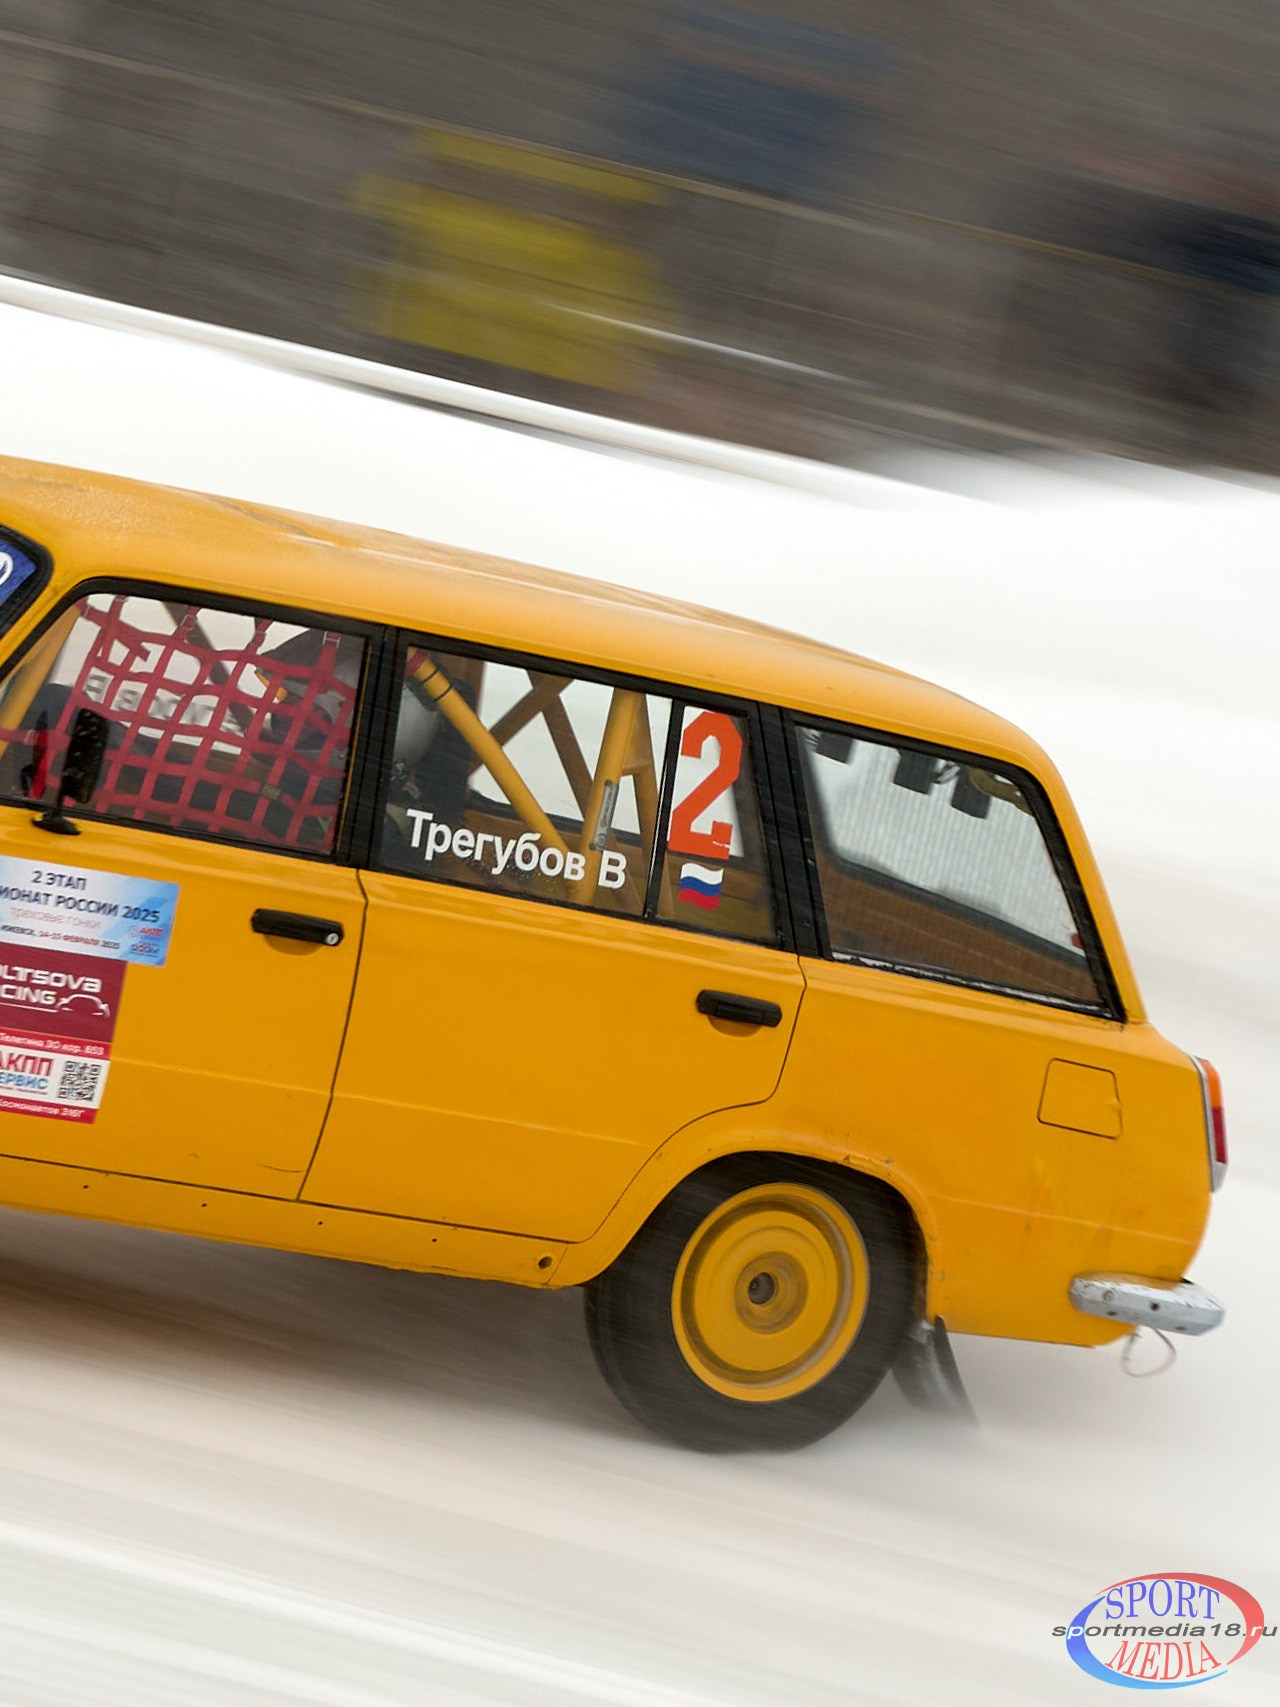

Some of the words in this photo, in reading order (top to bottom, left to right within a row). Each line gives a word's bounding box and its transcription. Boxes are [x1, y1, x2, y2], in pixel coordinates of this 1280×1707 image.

[666, 711, 743, 860] 2
[406, 809, 585, 881] Трегубов
[598, 850, 627, 889] В
[31, 870, 42, 884] 2
[46, 872, 87, 890] ЭТАП
[55, 895, 120, 917] РОССИИ
[122, 905, 160, 923] 2025
